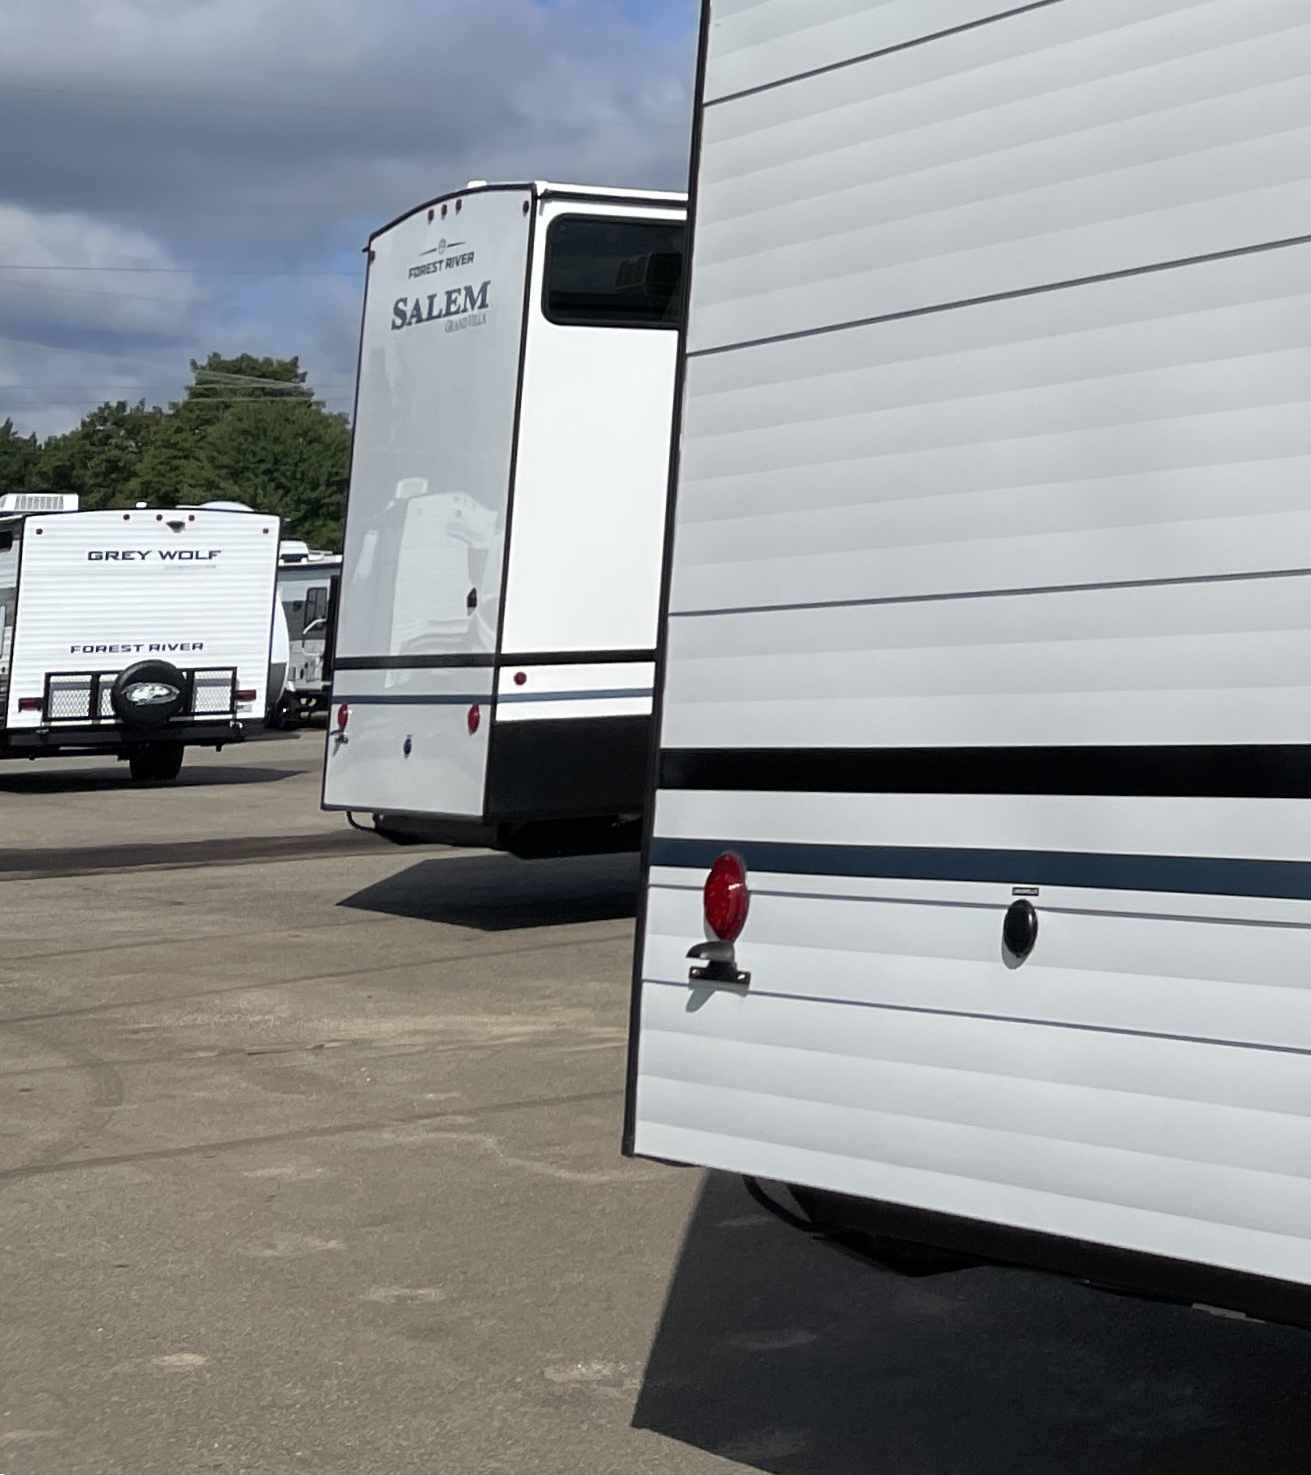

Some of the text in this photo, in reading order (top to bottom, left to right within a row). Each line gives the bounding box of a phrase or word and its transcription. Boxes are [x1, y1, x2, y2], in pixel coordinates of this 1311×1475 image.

[408, 251, 475, 280] FOREST RIVER
[390, 280, 492, 331] SALEM
[87, 550, 222, 561] GREY WOLF
[70, 642, 204, 654] FOREST RIVER
